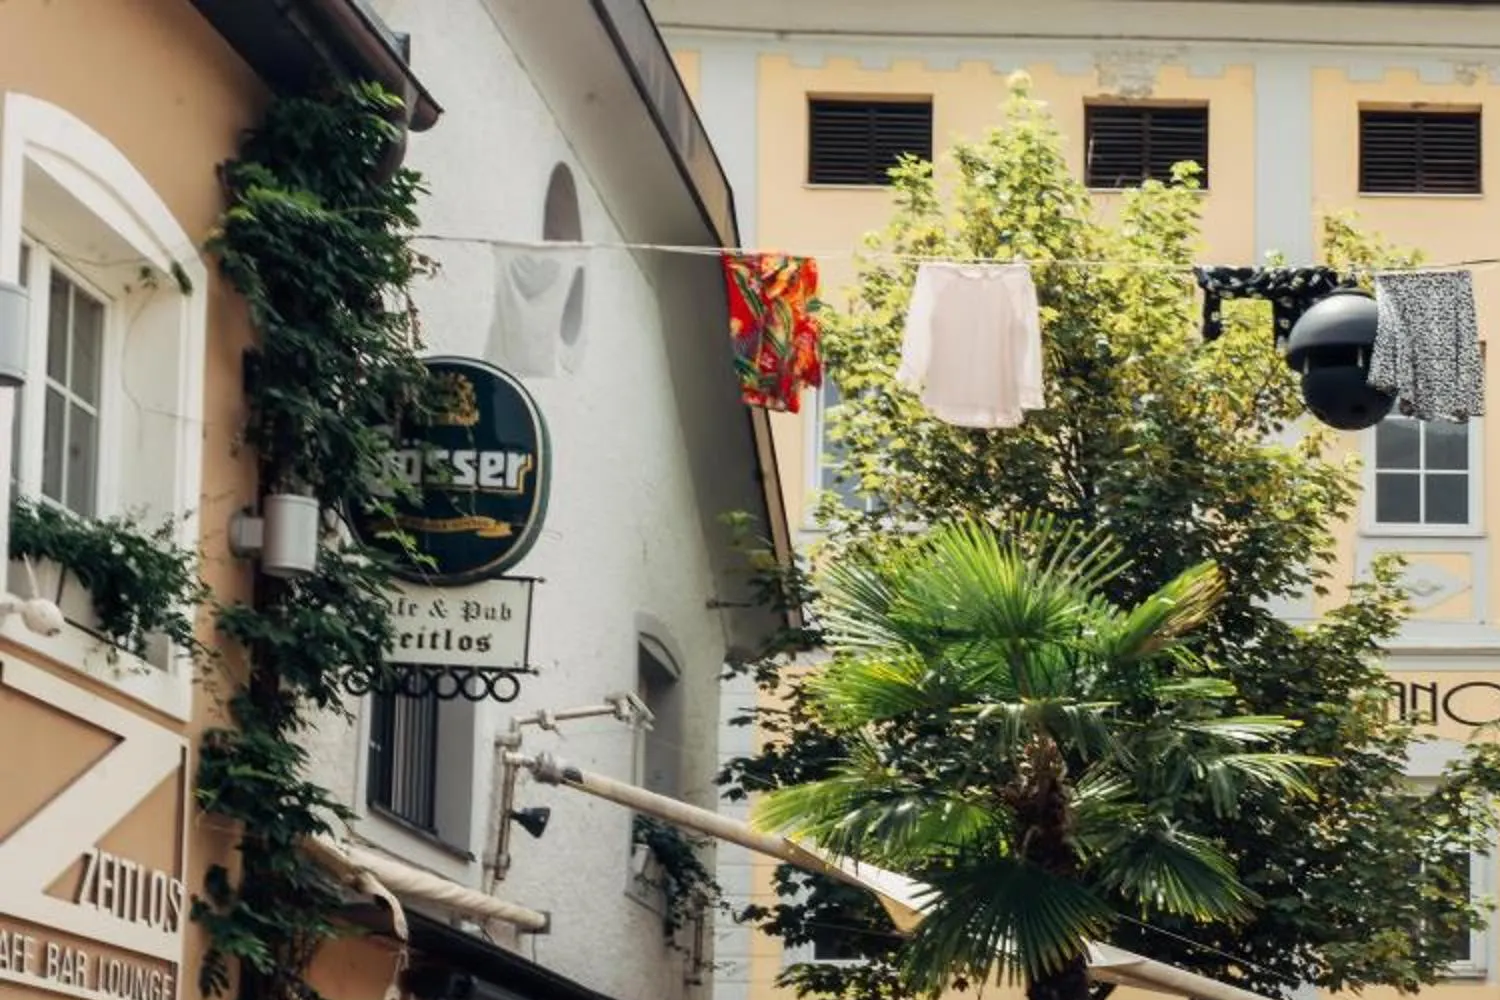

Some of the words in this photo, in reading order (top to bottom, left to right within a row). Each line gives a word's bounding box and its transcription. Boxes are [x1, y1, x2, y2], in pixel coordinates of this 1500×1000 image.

[428, 598, 448, 619] &
[461, 599, 512, 623] Pub
[399, 625, 492, 653] eitlos
[76, 848, 185, 934] ZEITLOS
[0, 928, 37, 975] AFE
[46, 941, 89, 988] BAR
